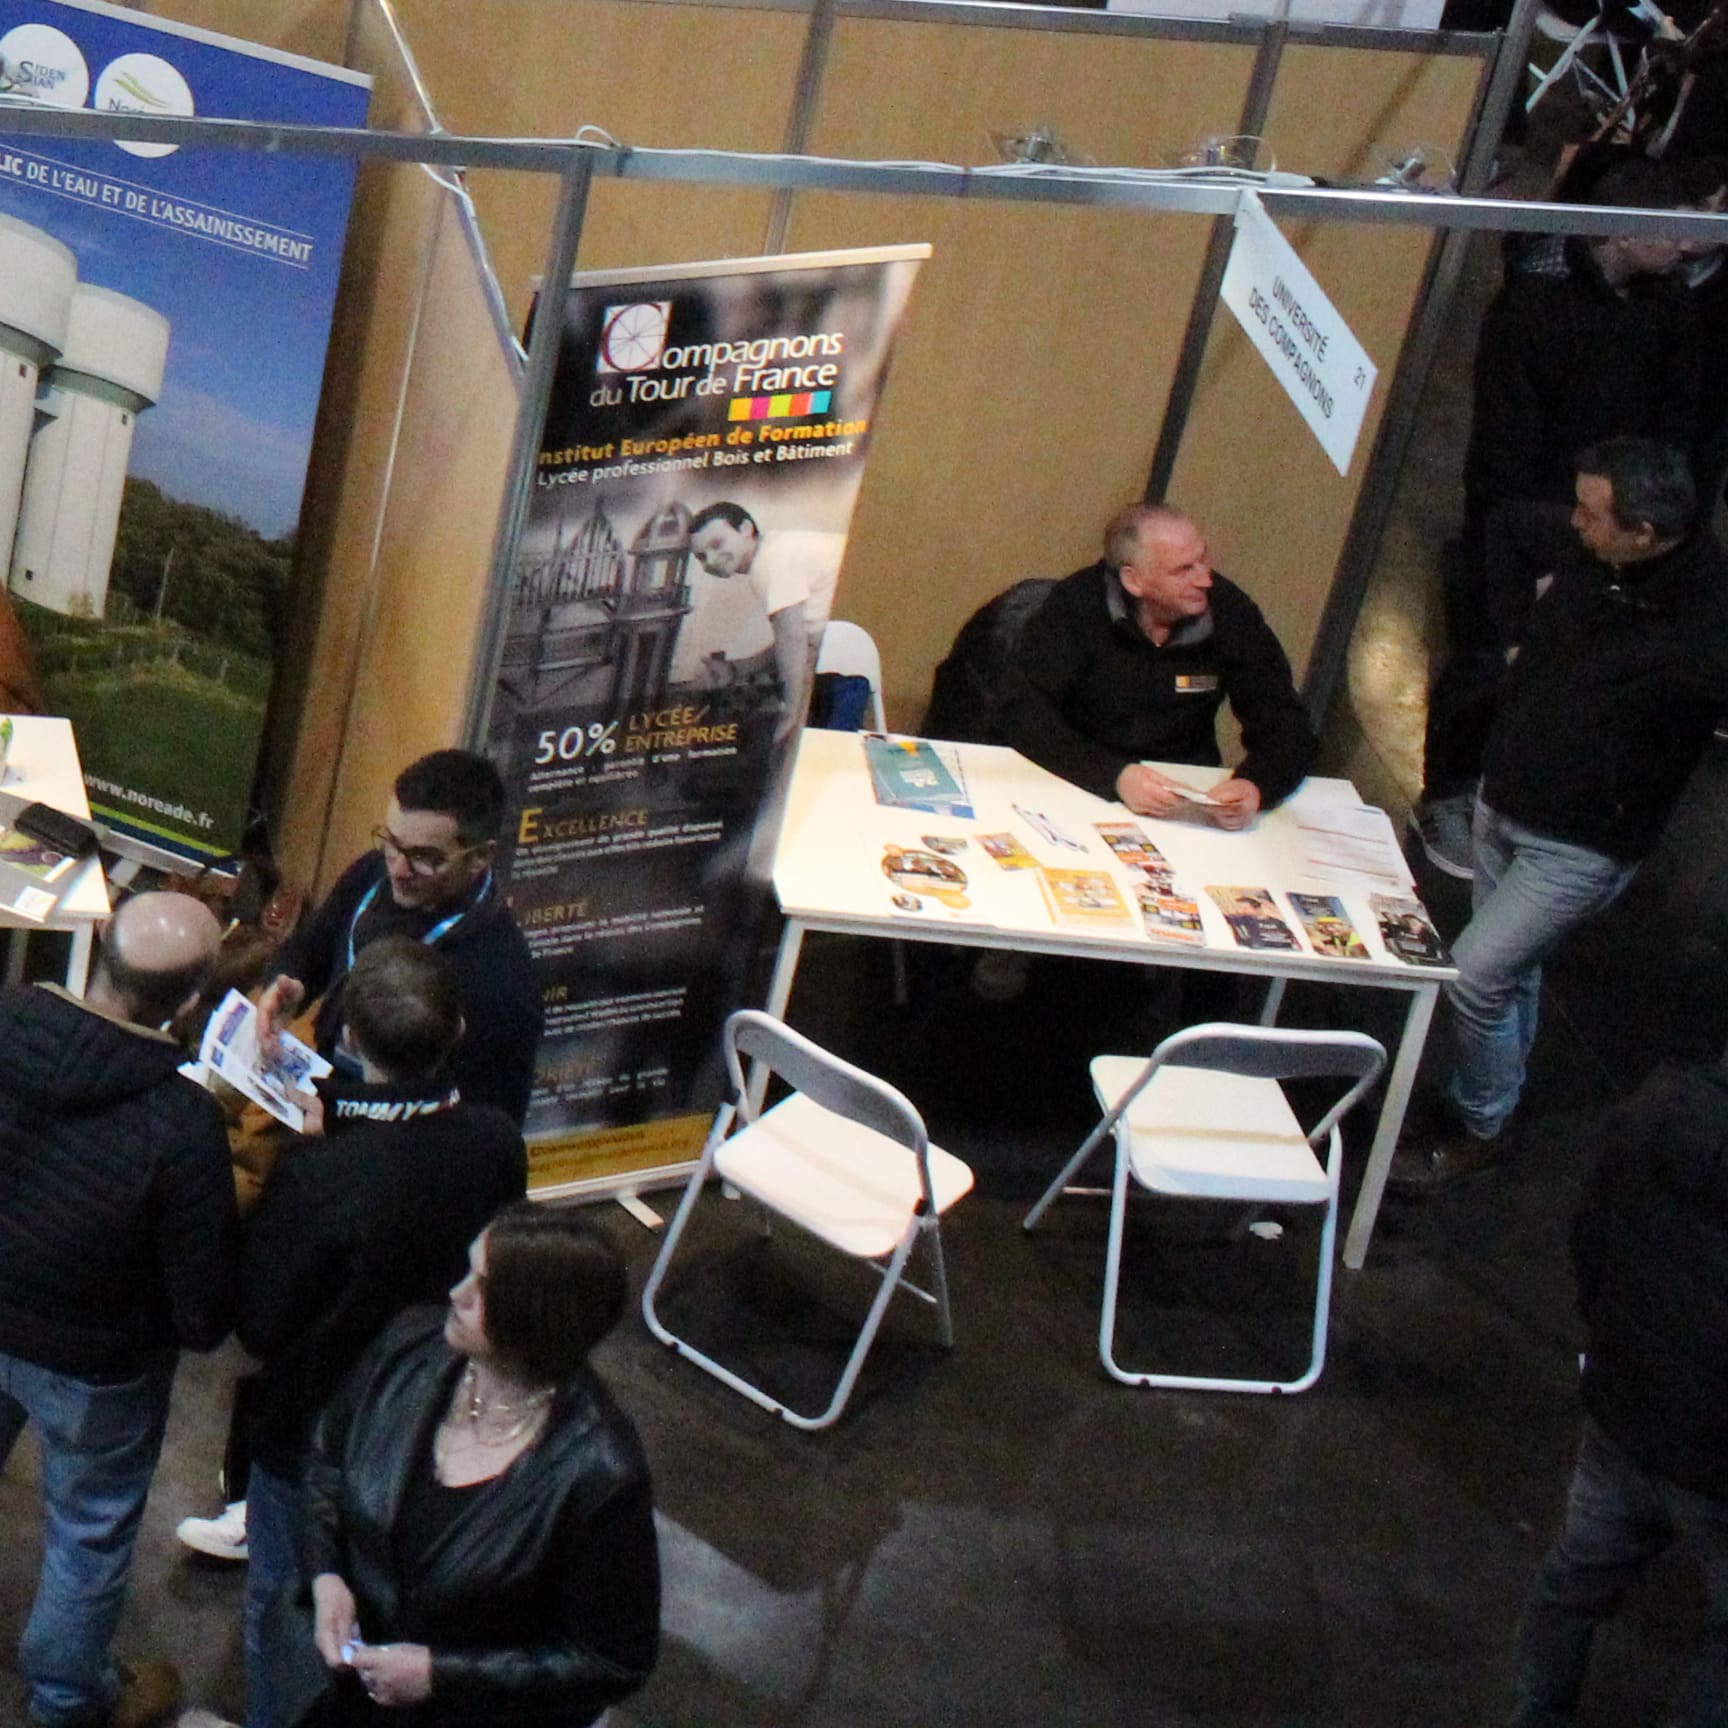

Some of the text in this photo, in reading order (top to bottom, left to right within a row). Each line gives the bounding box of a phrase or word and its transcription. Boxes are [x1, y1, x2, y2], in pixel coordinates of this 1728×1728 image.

[26, 161, 49, 184] DE
[52, 168, 99, 199] L'EAU
[101, 182, 123, 205] ET
[125, 189, 148, 213] DE
[150, 196, 314, 264] L'ASSAINISSEMENT
[1271, 274, 1330, 364] UNIVERSITÉ
[1248, 287, 1334, 420] DES COMPAGNONS
[589, 362, 839, 408] du Tour de France
[1353, 365, 1368, 391] 21
[619, 418, 869, 458] Européen de Formation
[537, 440, 855, 489] Lycée professionnel Bois et Bâtiment
[534, 720, 619, 766] 50%
[624, 722, 739, 754] ENTREPRISE
[335, 1099, 425, 1122] TOMMY
